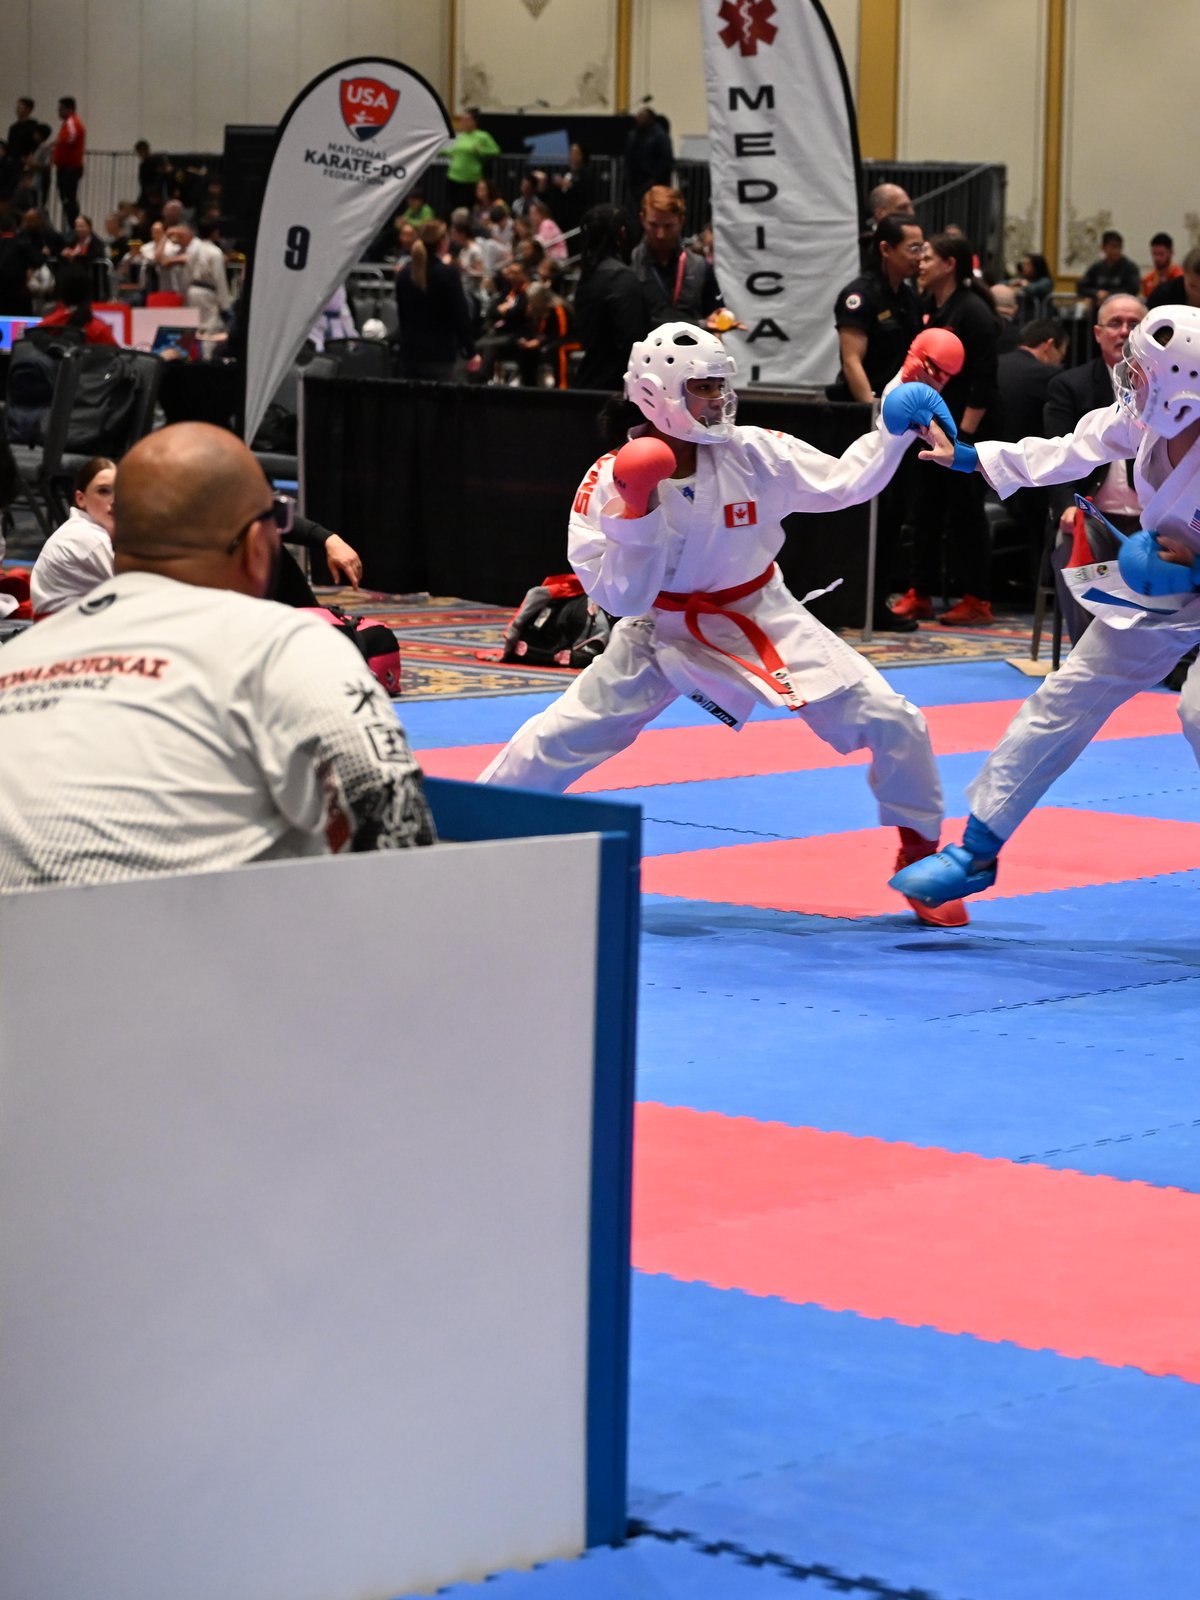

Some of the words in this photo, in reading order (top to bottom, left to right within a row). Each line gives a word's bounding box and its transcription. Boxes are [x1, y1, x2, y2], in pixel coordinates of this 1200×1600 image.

[346, 84, 390, 110] USA
[303, 149, 407, 180] KARATE-DO
[284, 225, 311, 271] 9
